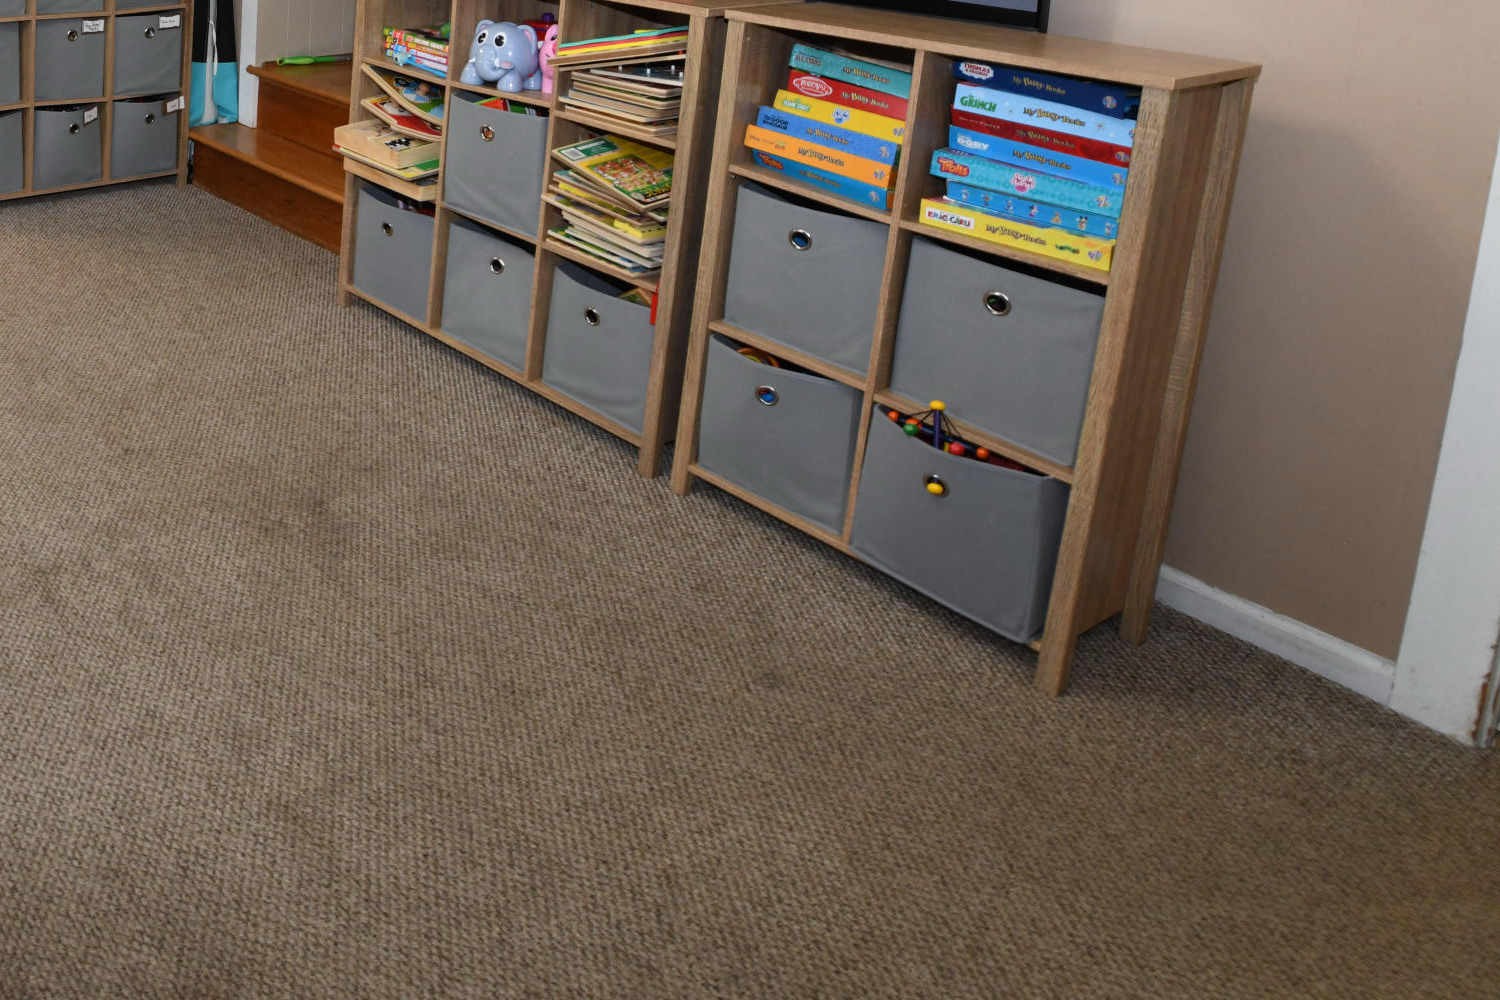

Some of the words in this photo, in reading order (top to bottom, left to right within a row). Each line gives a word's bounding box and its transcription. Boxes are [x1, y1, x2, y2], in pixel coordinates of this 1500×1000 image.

[1023, 77, 1044, 90] Busy
[960, 95, 997, 113] GRINCH
[1035, 107, 1061, 122] Busy
[1061, 114, 1086, 127] Books
[1024, 150, 1049, 165] Busy
[938, 157, 969, 177] Trolls
